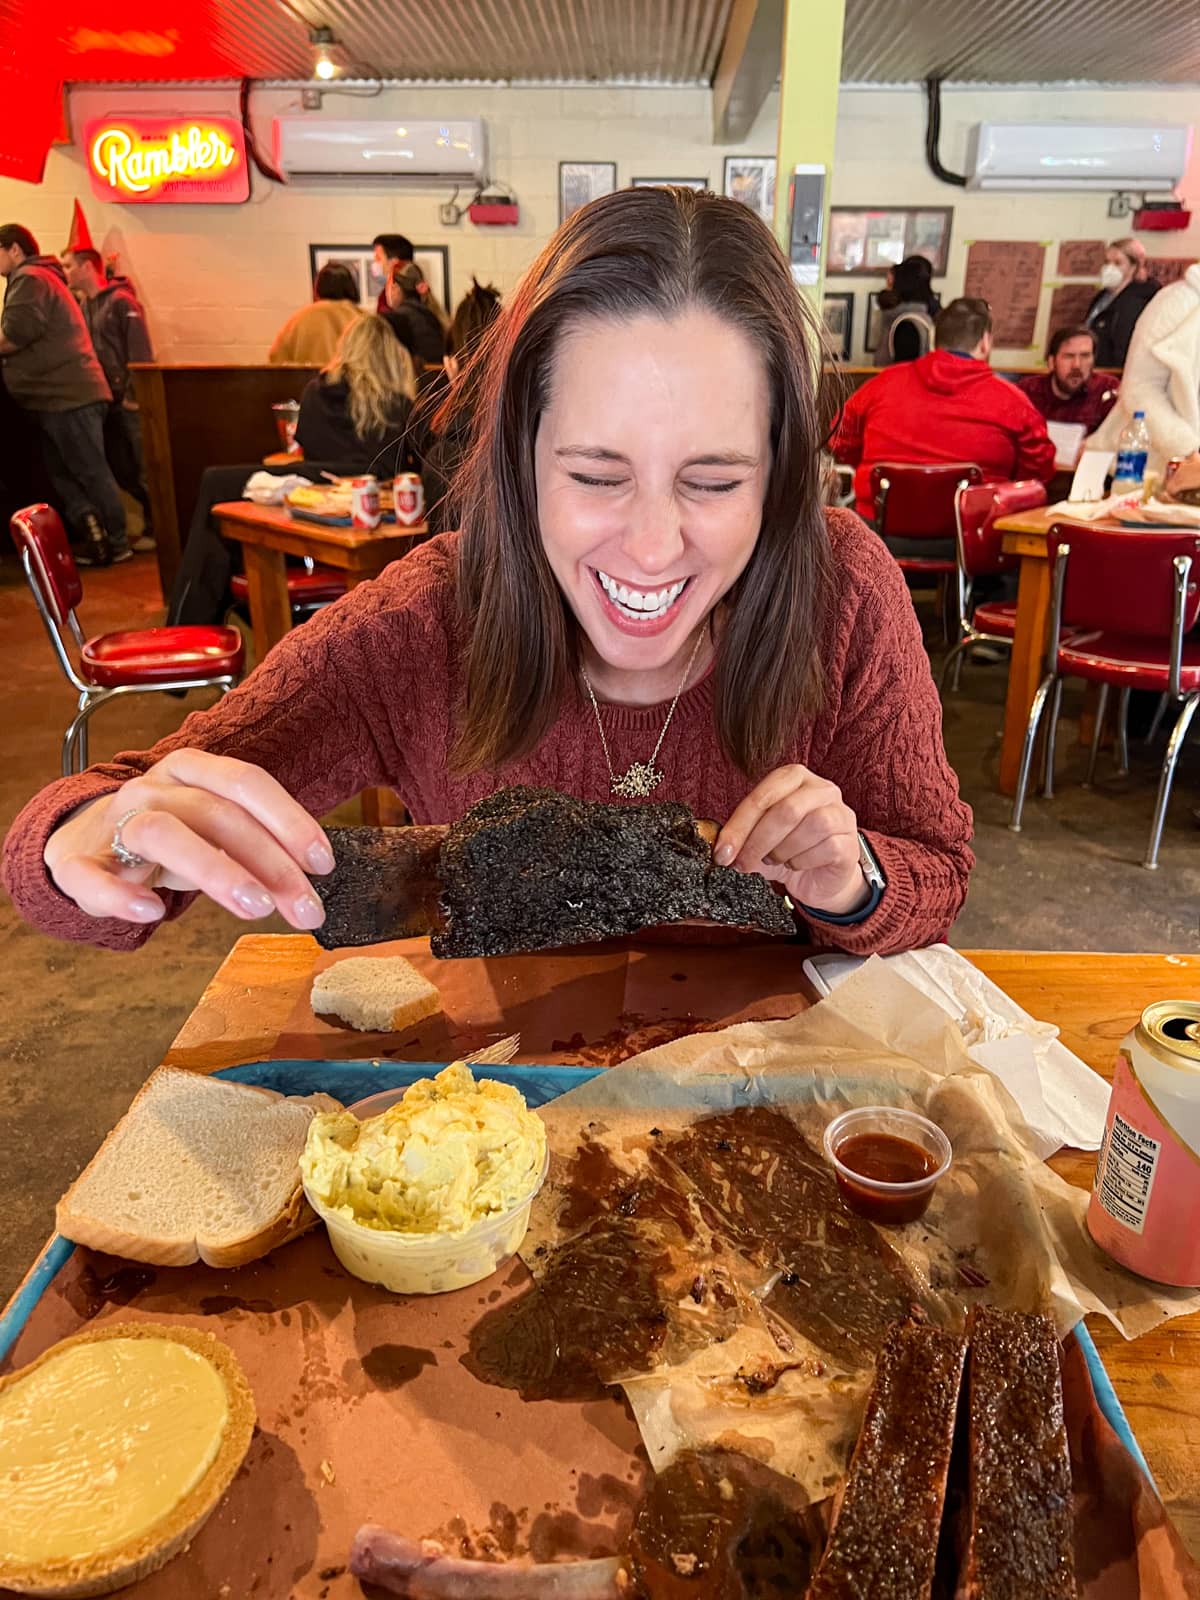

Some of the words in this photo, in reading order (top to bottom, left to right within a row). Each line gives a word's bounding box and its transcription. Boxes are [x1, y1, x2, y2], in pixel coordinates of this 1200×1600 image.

[92, 126, 236, 192] Rambler
[1115, 1115, 1137, 1137] Nutrition
[1138, 1134, 1156, 1149] Facts
[1137, 1160, 1151, 1174] 140
